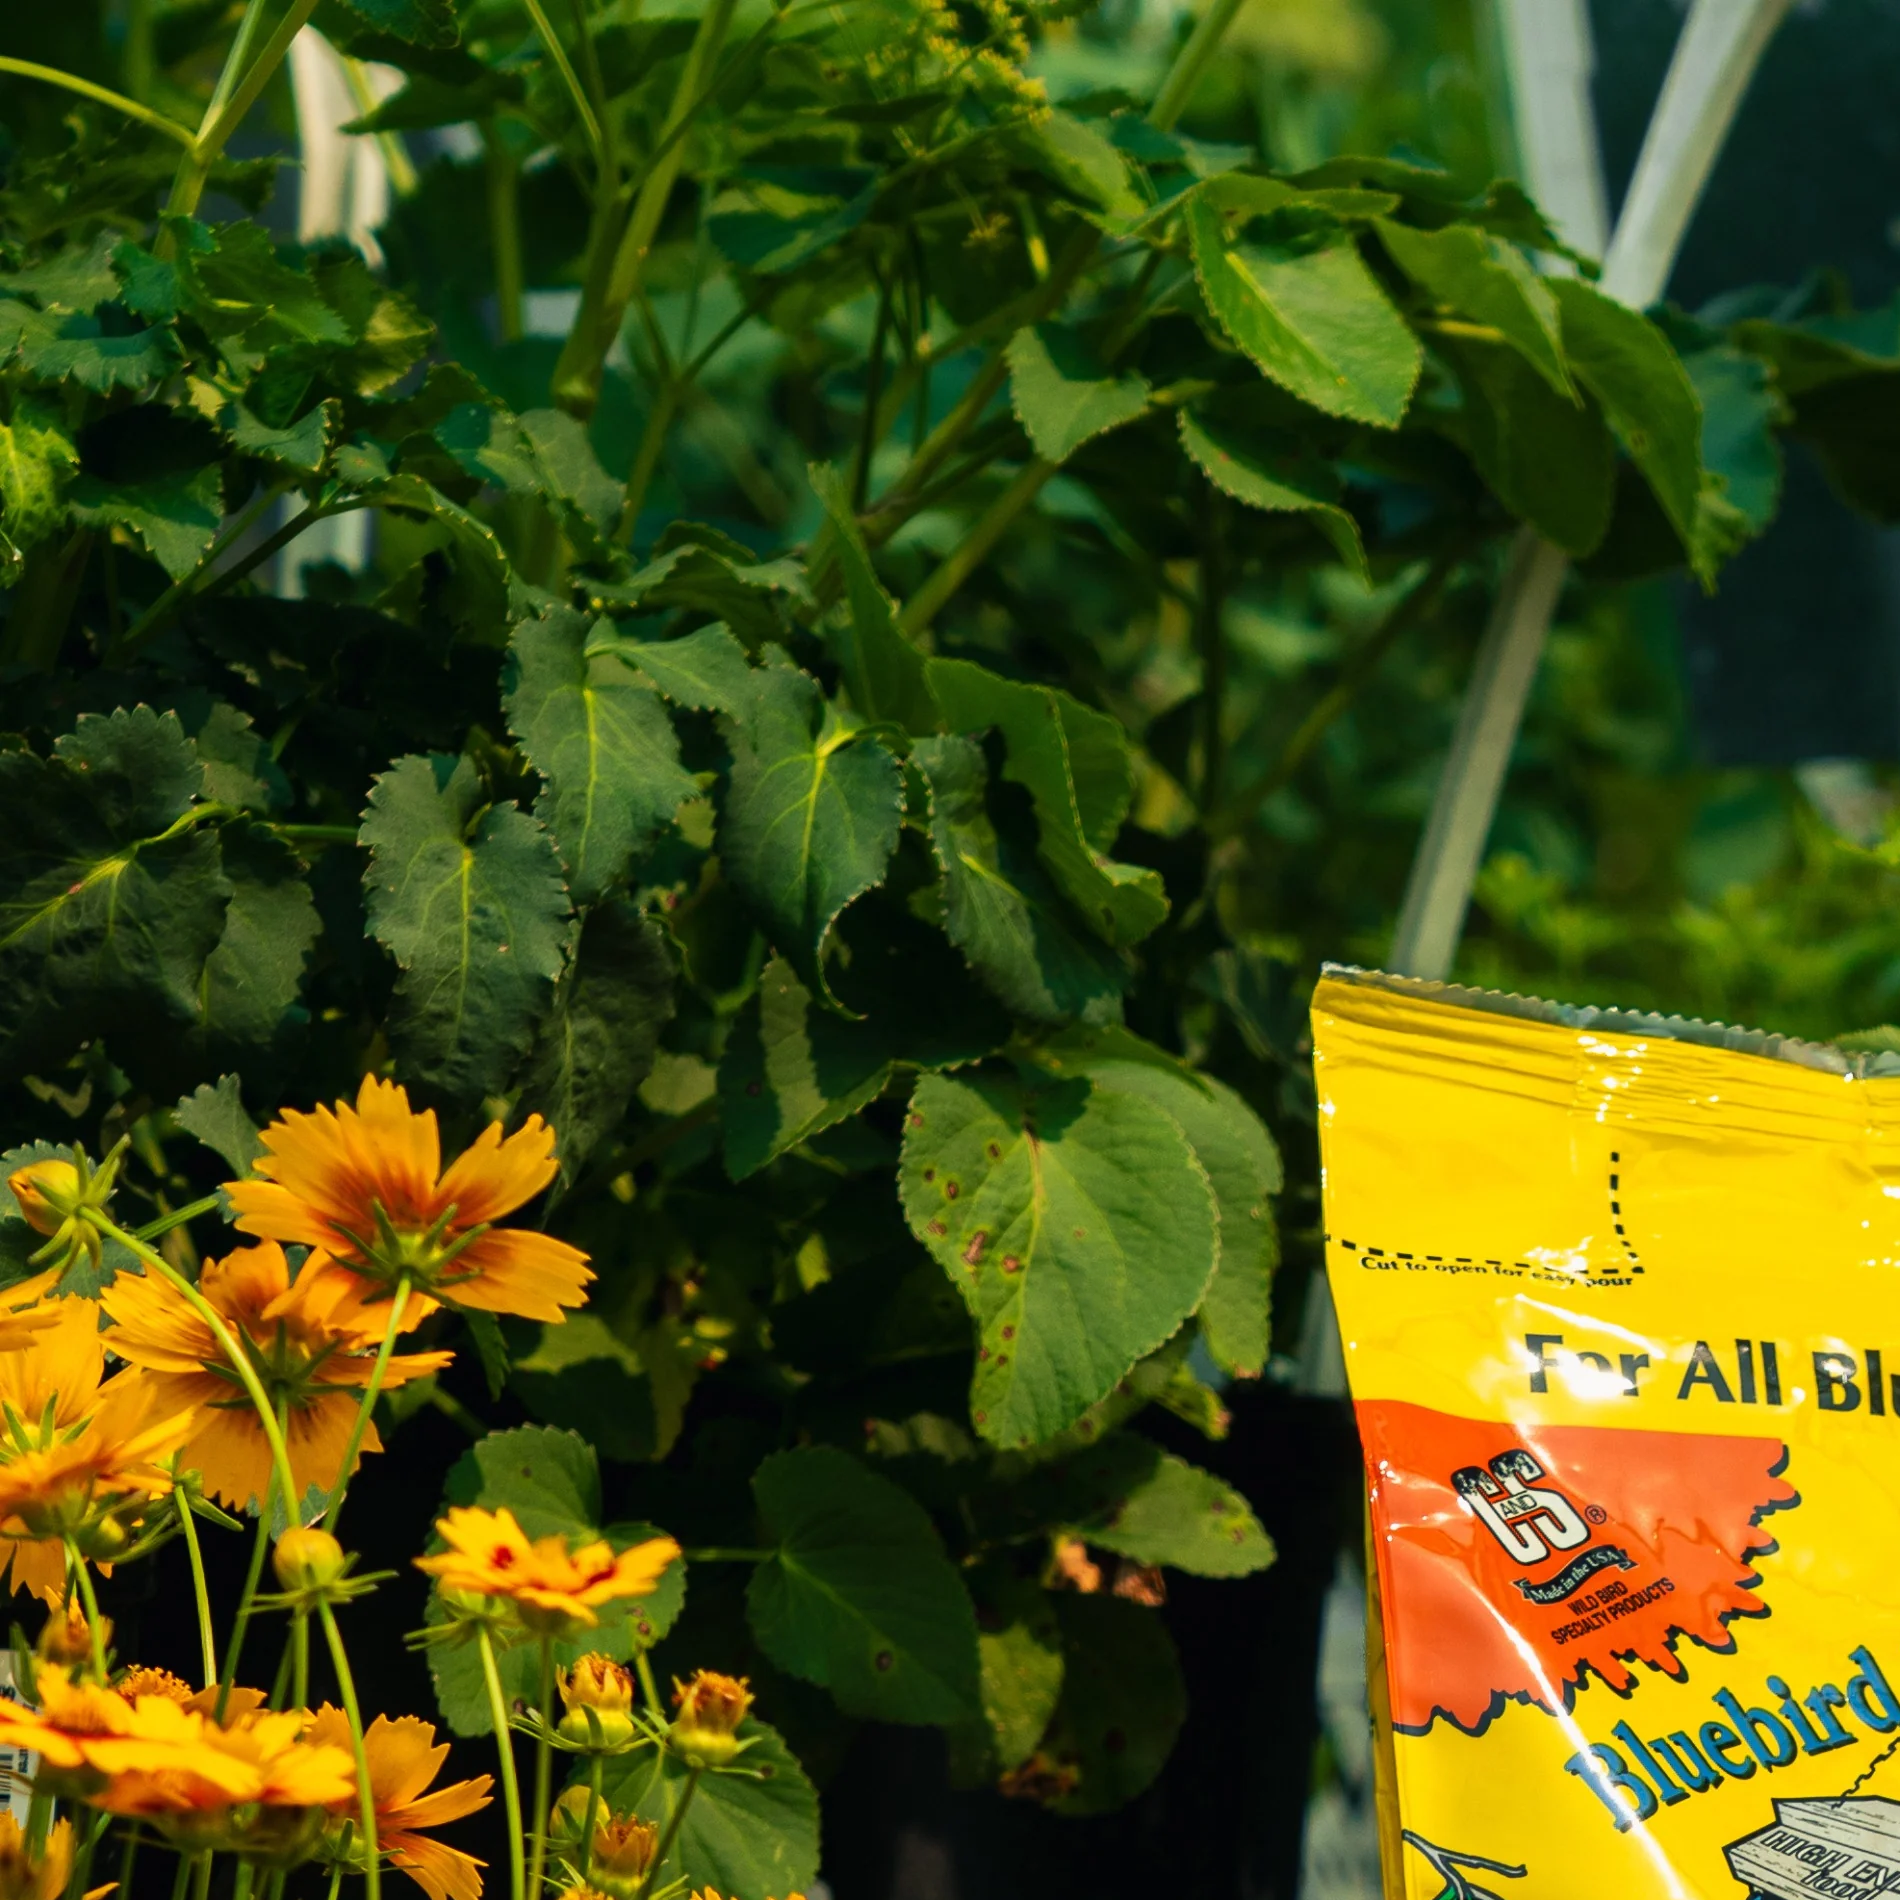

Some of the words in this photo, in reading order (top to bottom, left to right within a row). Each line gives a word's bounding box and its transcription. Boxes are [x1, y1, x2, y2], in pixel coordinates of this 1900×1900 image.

[1361, 1257, 1399, 1271] Cut
[1406, 1261, 1427, 1272] to
[1435, 1264, 1487, 1275] open
[1494, 1264, 1523, 1277] for
[1585, 1277, 1634, 1288] pour
[1676, 1338, 1783, 1406] All
[1531, 1584, 1566, 1601] Made
[1561, 1578, 1576, 1591] in
[1571, 1563, 1590, 1581] the
[1586, 1550, 1620, 1567] USA
[1567, 1594, 1600, 1616] WILD
[1595, 1580, 1628, 1605] BIRD
[1550, 1609, 1612, 1645] SPECIALTY
[1606, 1576, 1675, 1621] PRODUCTS
[1760, 1829, 1853, 1873] HIGH
